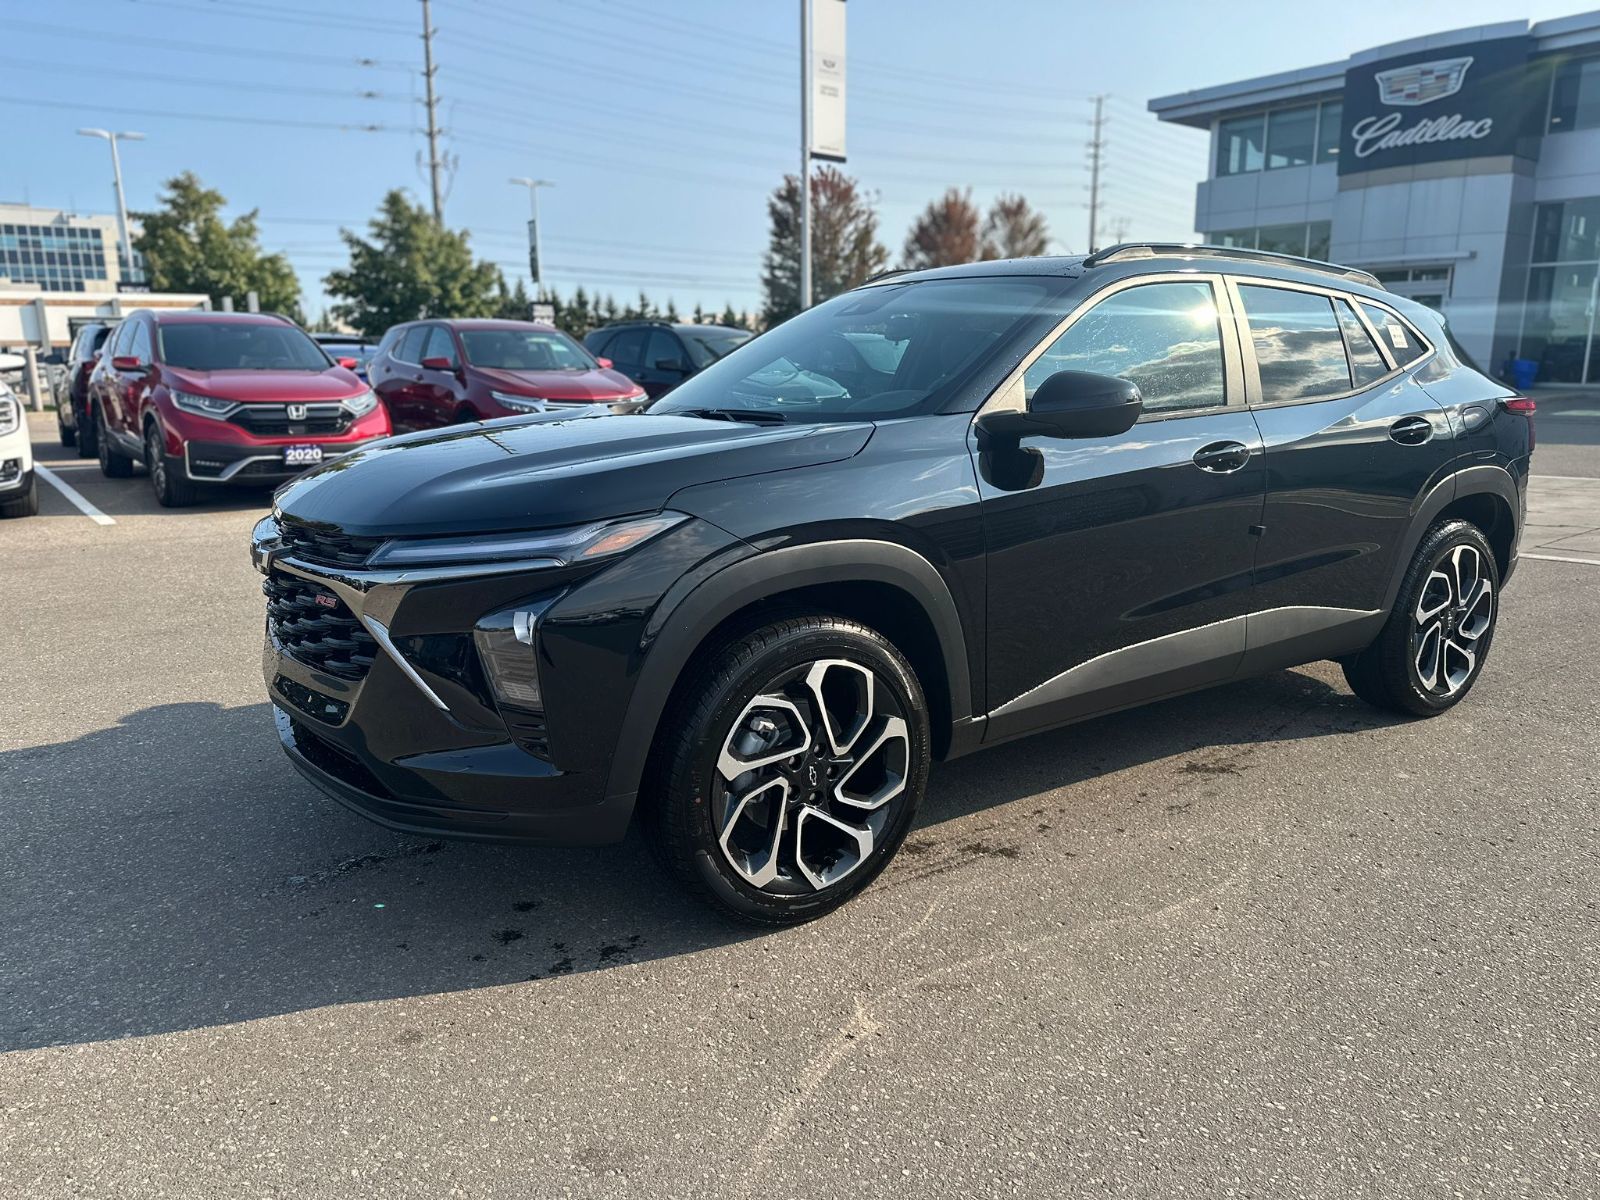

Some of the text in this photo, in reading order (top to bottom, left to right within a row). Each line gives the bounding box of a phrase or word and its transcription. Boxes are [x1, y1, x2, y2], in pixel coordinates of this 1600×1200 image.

[1352, 112, 1492, 157] Cadillac
[286, 448, 322, 460] 2020
[315, 594, 337, 608] RS
